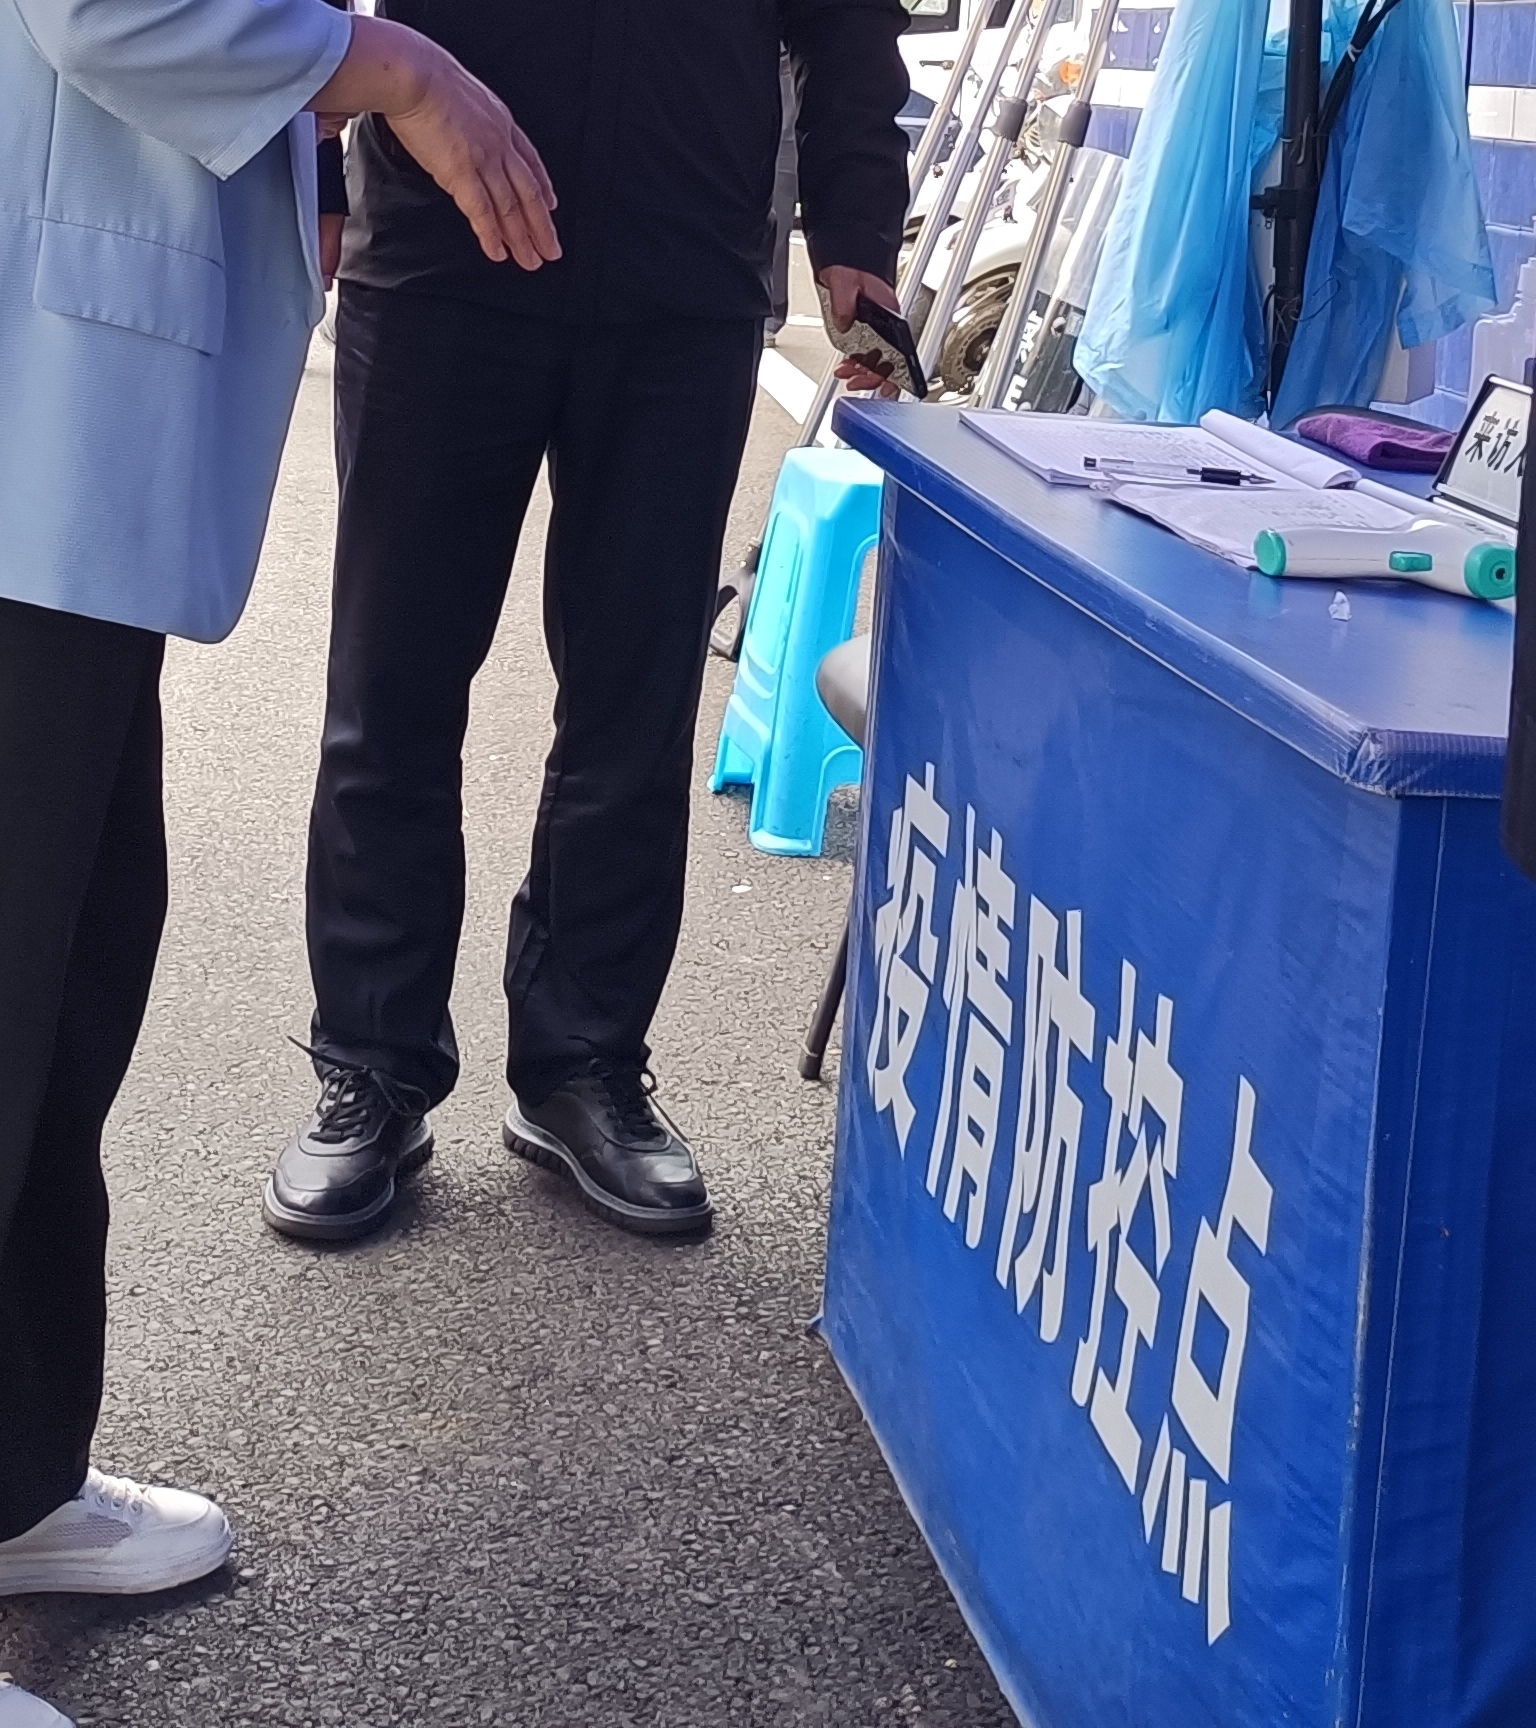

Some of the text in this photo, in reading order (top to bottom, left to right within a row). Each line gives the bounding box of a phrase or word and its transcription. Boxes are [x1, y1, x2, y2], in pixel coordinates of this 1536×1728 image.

[866, 761, 1273, 1647] 疫情防控点
